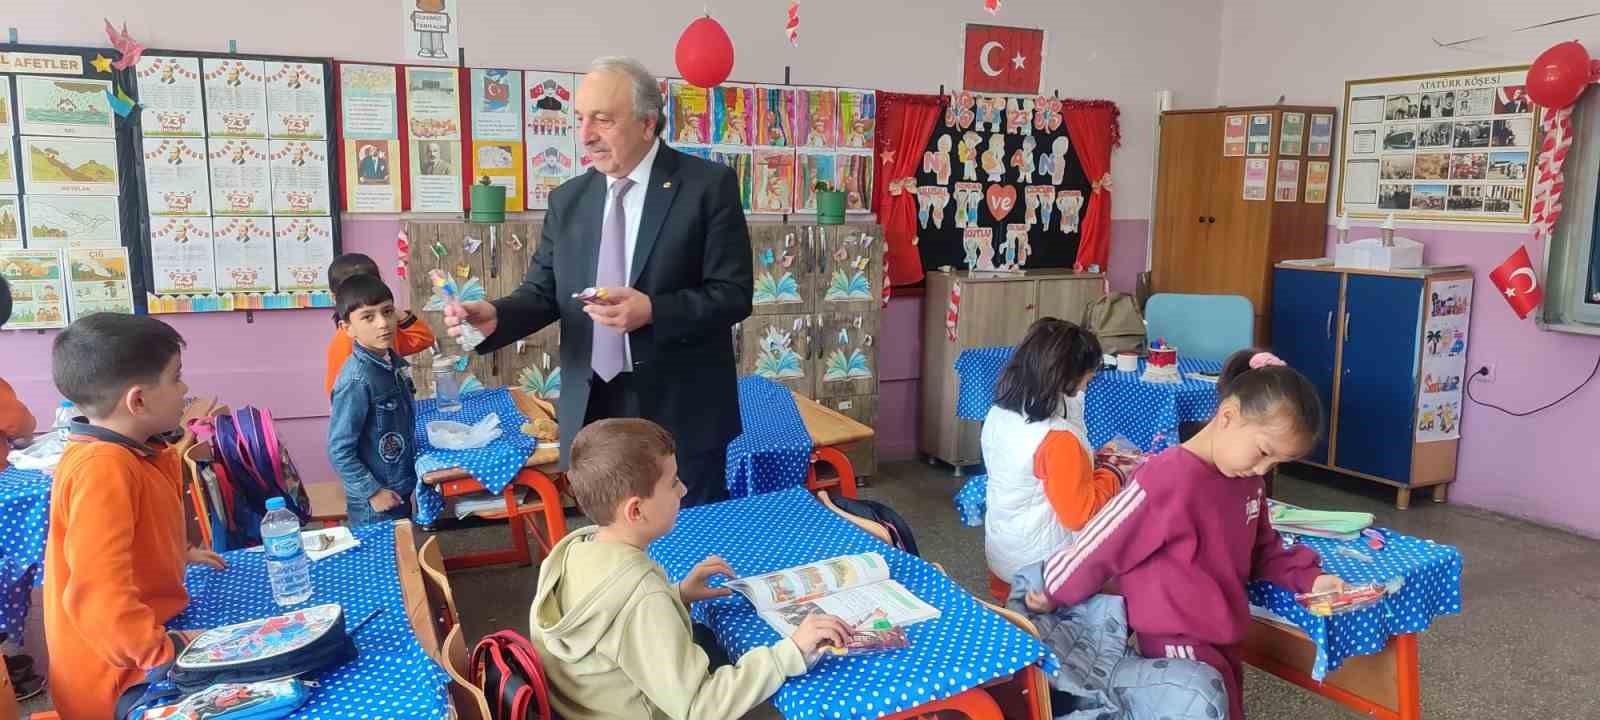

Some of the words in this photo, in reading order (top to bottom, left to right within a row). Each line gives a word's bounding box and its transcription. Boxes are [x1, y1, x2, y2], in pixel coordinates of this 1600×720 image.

[14, 57, 79, 70] AFETLER
[1419, 78, 1462, 89] ATATÜRK
[1464, 73, 1501, 87] KÖŞESİ
[991, 195, 1011, 210] ve
